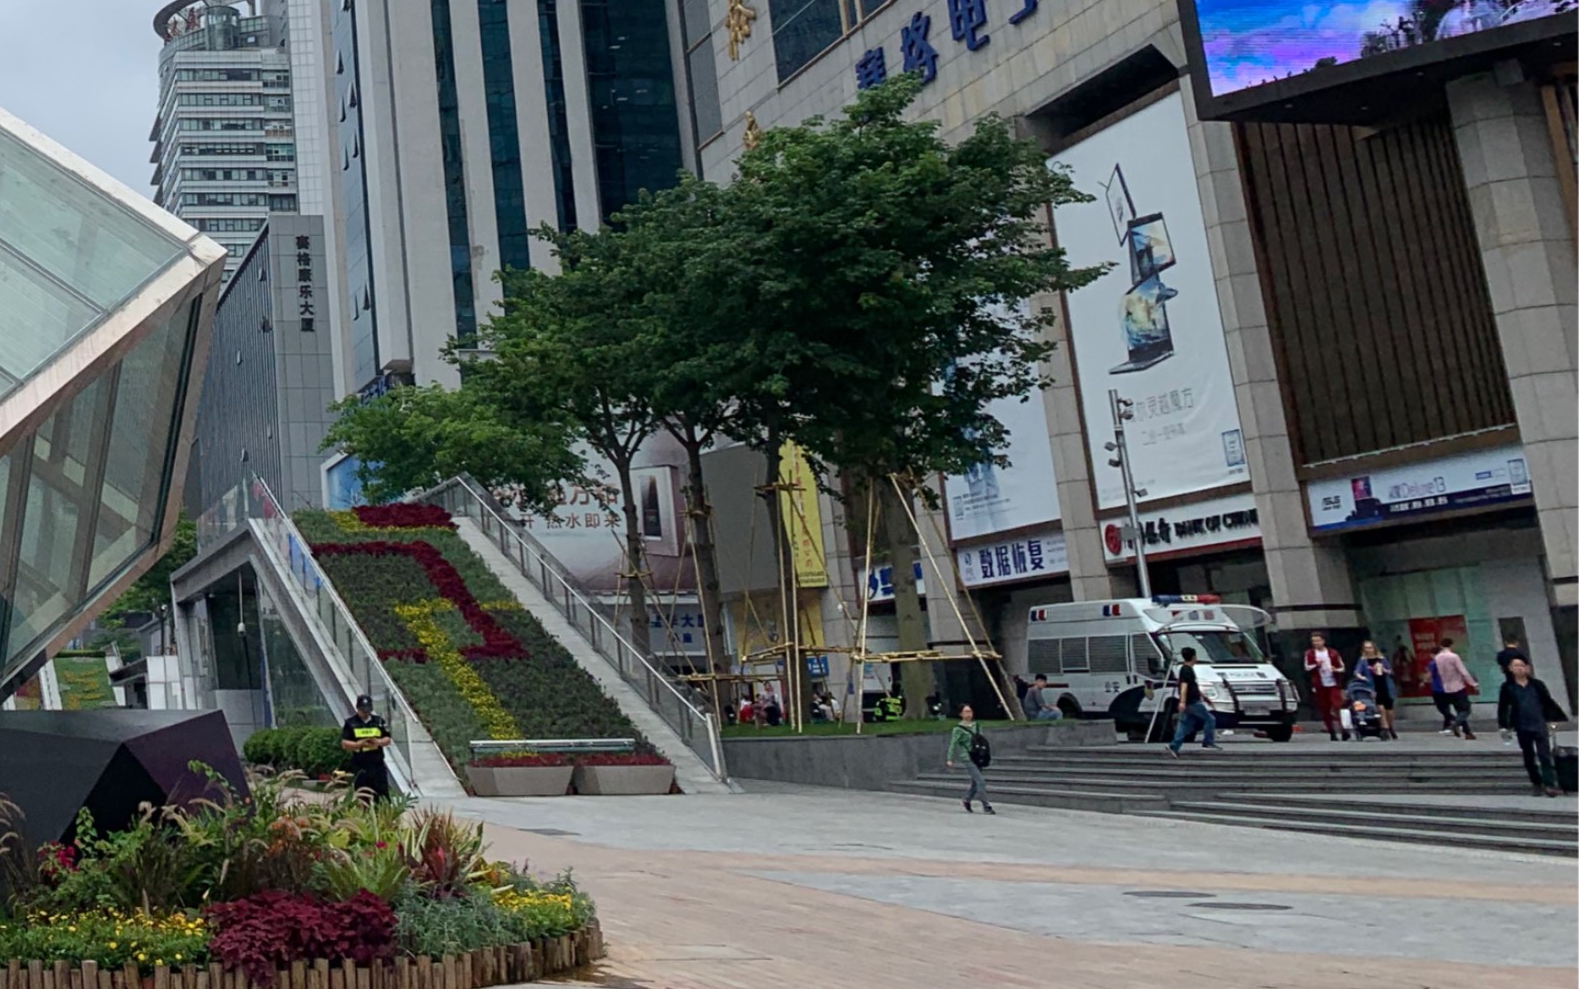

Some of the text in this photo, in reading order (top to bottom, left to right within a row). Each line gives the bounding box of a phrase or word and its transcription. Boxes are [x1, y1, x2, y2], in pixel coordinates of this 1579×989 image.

[295, 235, 316, 333] 赛格康乐大厦
[1131, 387, 1194, 423] 尔灵越魔方
[978, 540, 1045, 579] 数据恢复
[1104, 681, 1120, 693] 公安
